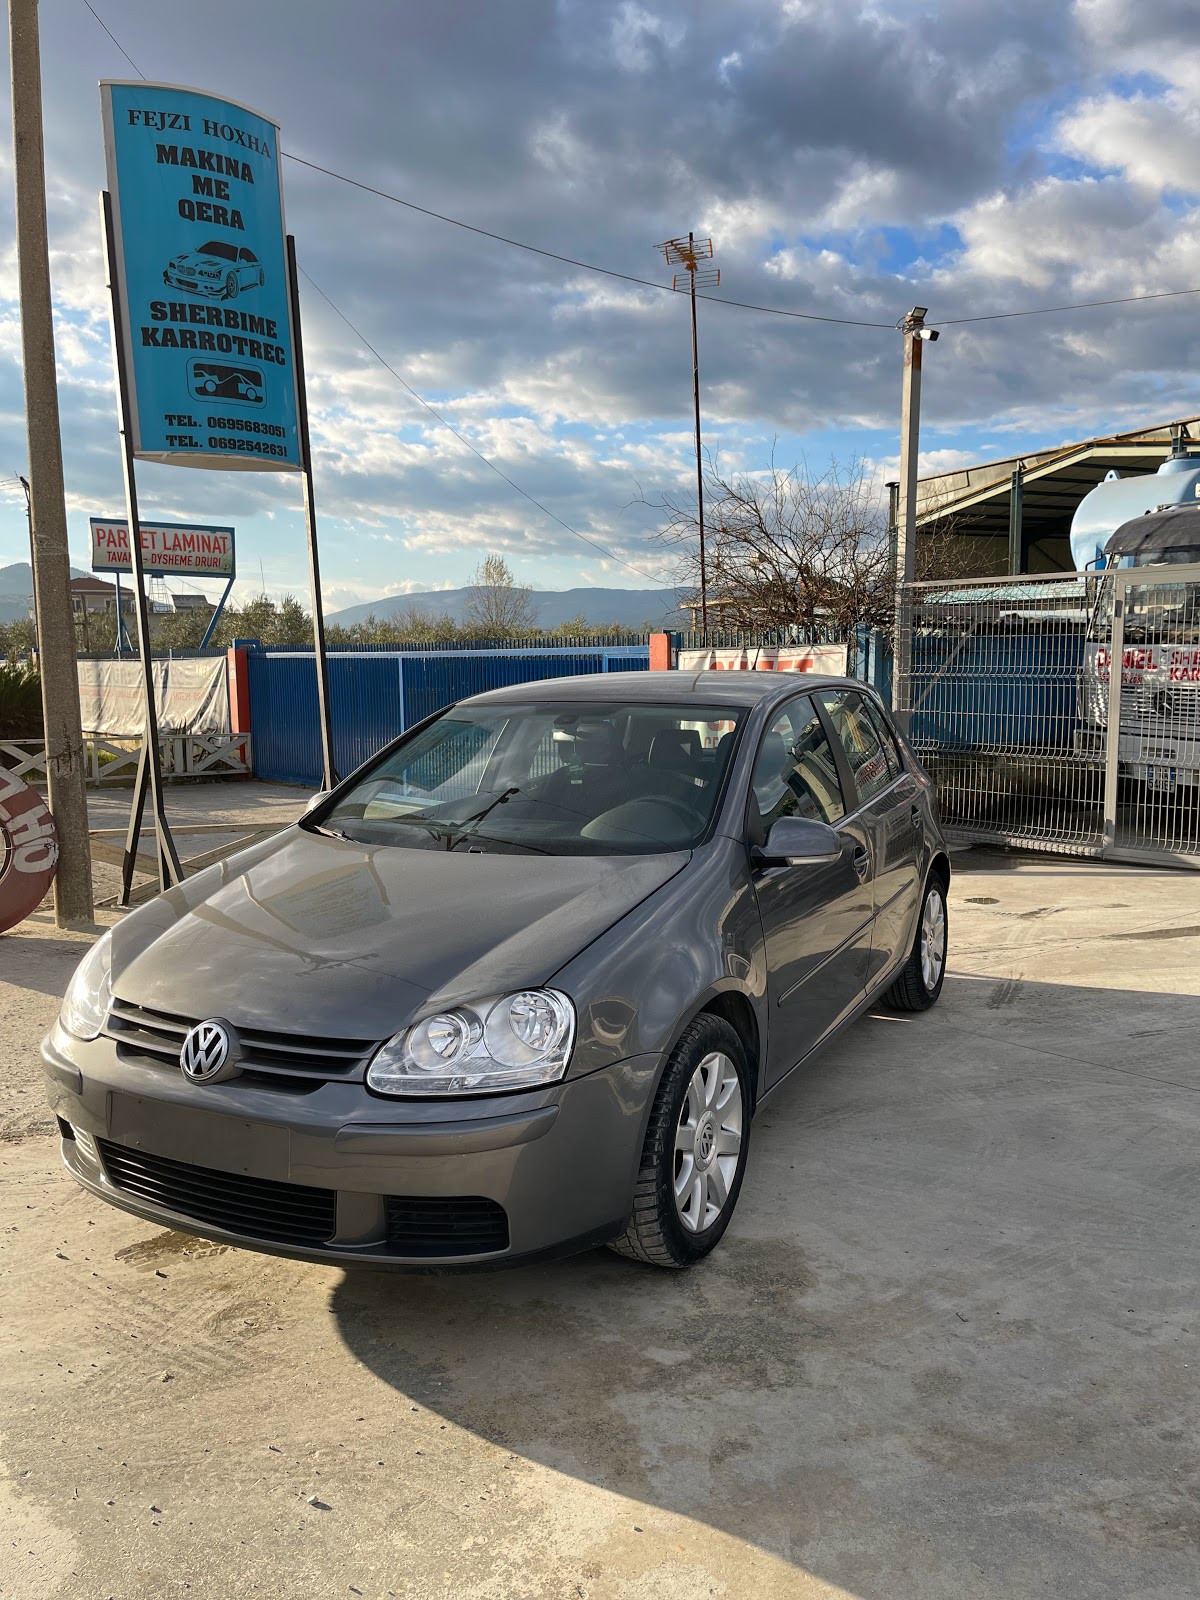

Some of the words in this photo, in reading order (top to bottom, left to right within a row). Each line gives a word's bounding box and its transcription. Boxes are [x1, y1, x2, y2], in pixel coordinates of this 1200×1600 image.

[127, 109, 192, 131] FEJZI
[202, 118, 272, 159] HOXHA
[155, 143, 255, 184] MAKINA
[191, 174, 231, 201] ME
[177, 198, 245, 231] QERA
[149, 300, 278, 340] SHERBIME
[140, 326, 286, 366] KARROTREC
[164, 414, 202, 428] TEL.
[207, 416, 287, 439] 0695683051
[165, 434, 203, 448] TEL.
[208, 436, 288, 458] 0692542631
[95, 527, 157, 550] PARET
[162, 531, 228, 555] LAMINAT
[151, 553, 193, 567] DYSHEME
[195, 556, 221, 568] DRURI
